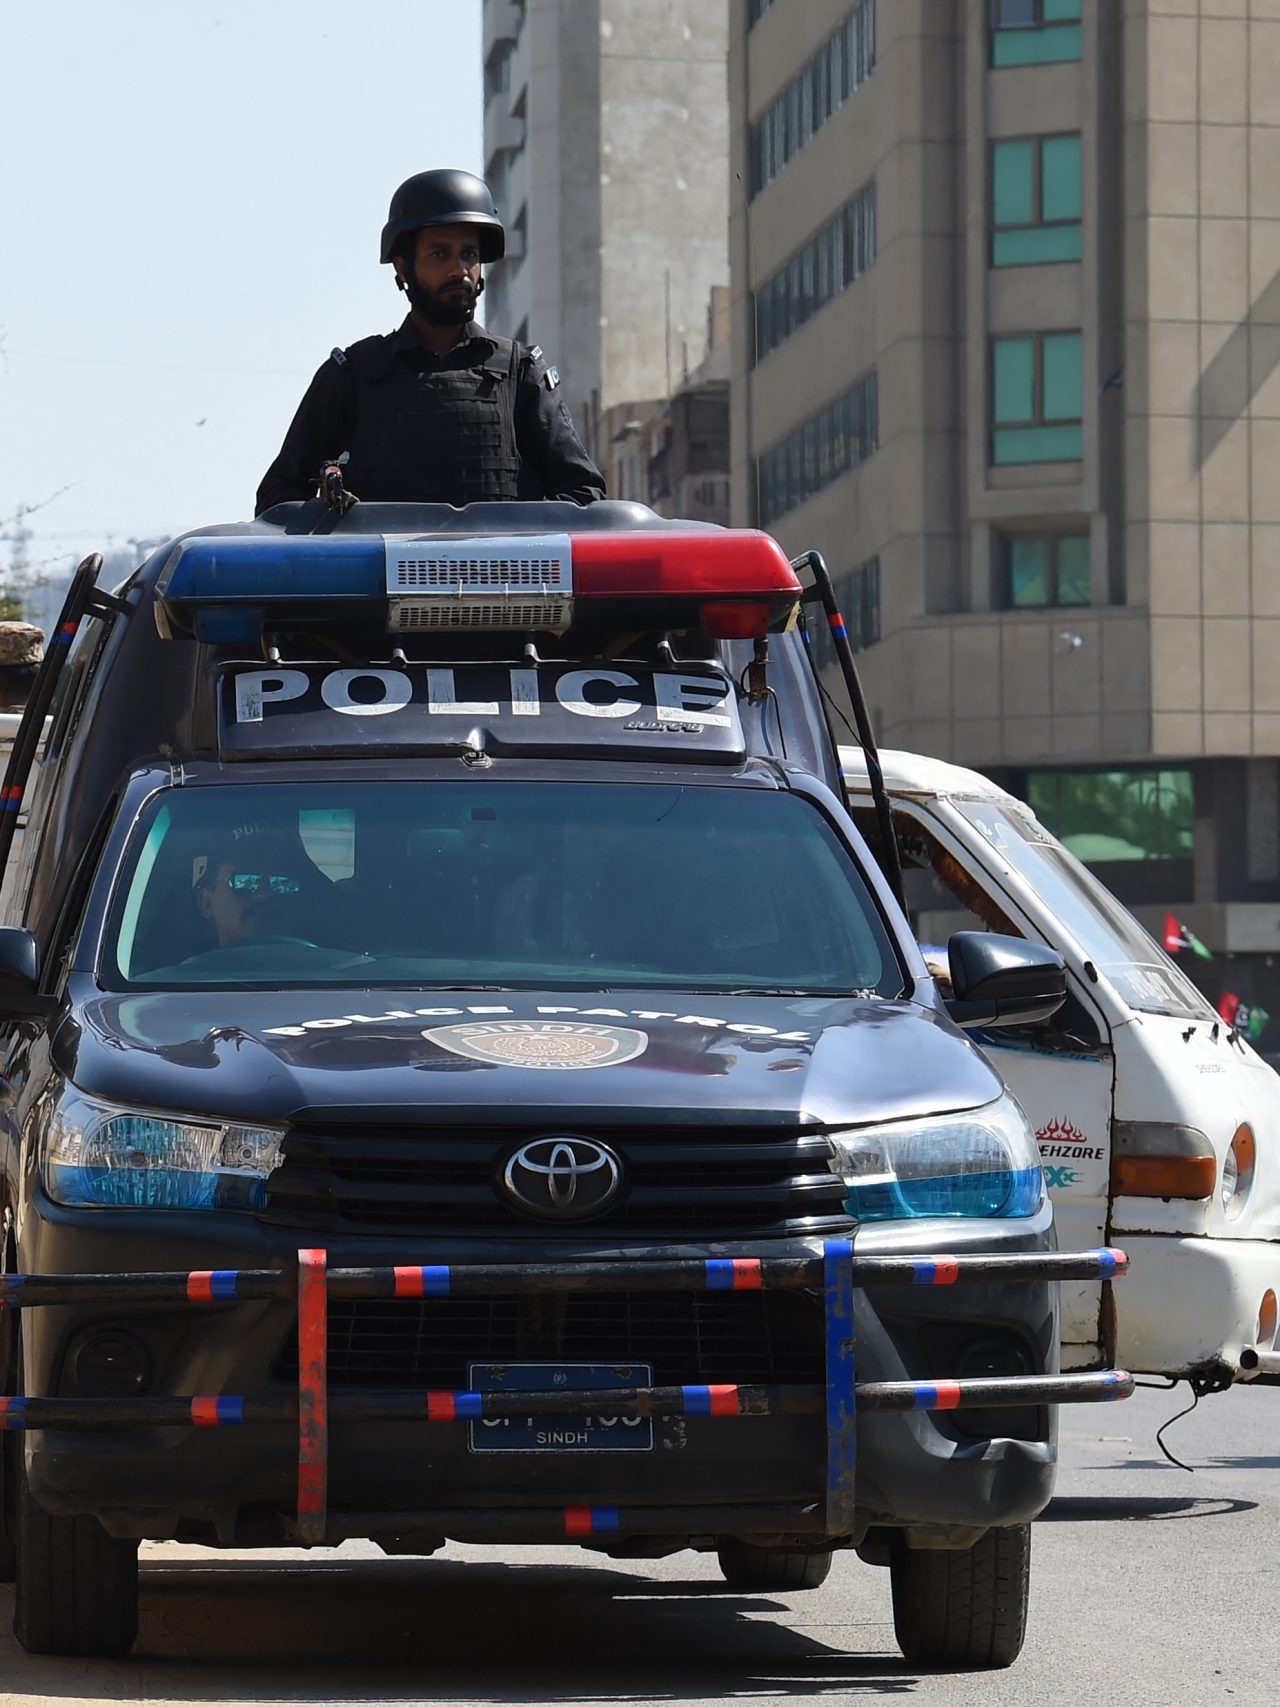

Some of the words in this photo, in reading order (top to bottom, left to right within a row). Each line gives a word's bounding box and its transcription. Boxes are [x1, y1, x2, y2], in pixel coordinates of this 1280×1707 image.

[235, 669, 733, 728] POLICE
[261, 1006, 514, 1037] POLICE
[536, 1006, 812, 1042] PATROL
[451, 1024, 614, 1036] SINDH
[1040, 1145, 1105, 1160] EHZORE
[536, 1431, 589, 1449] SINDH
